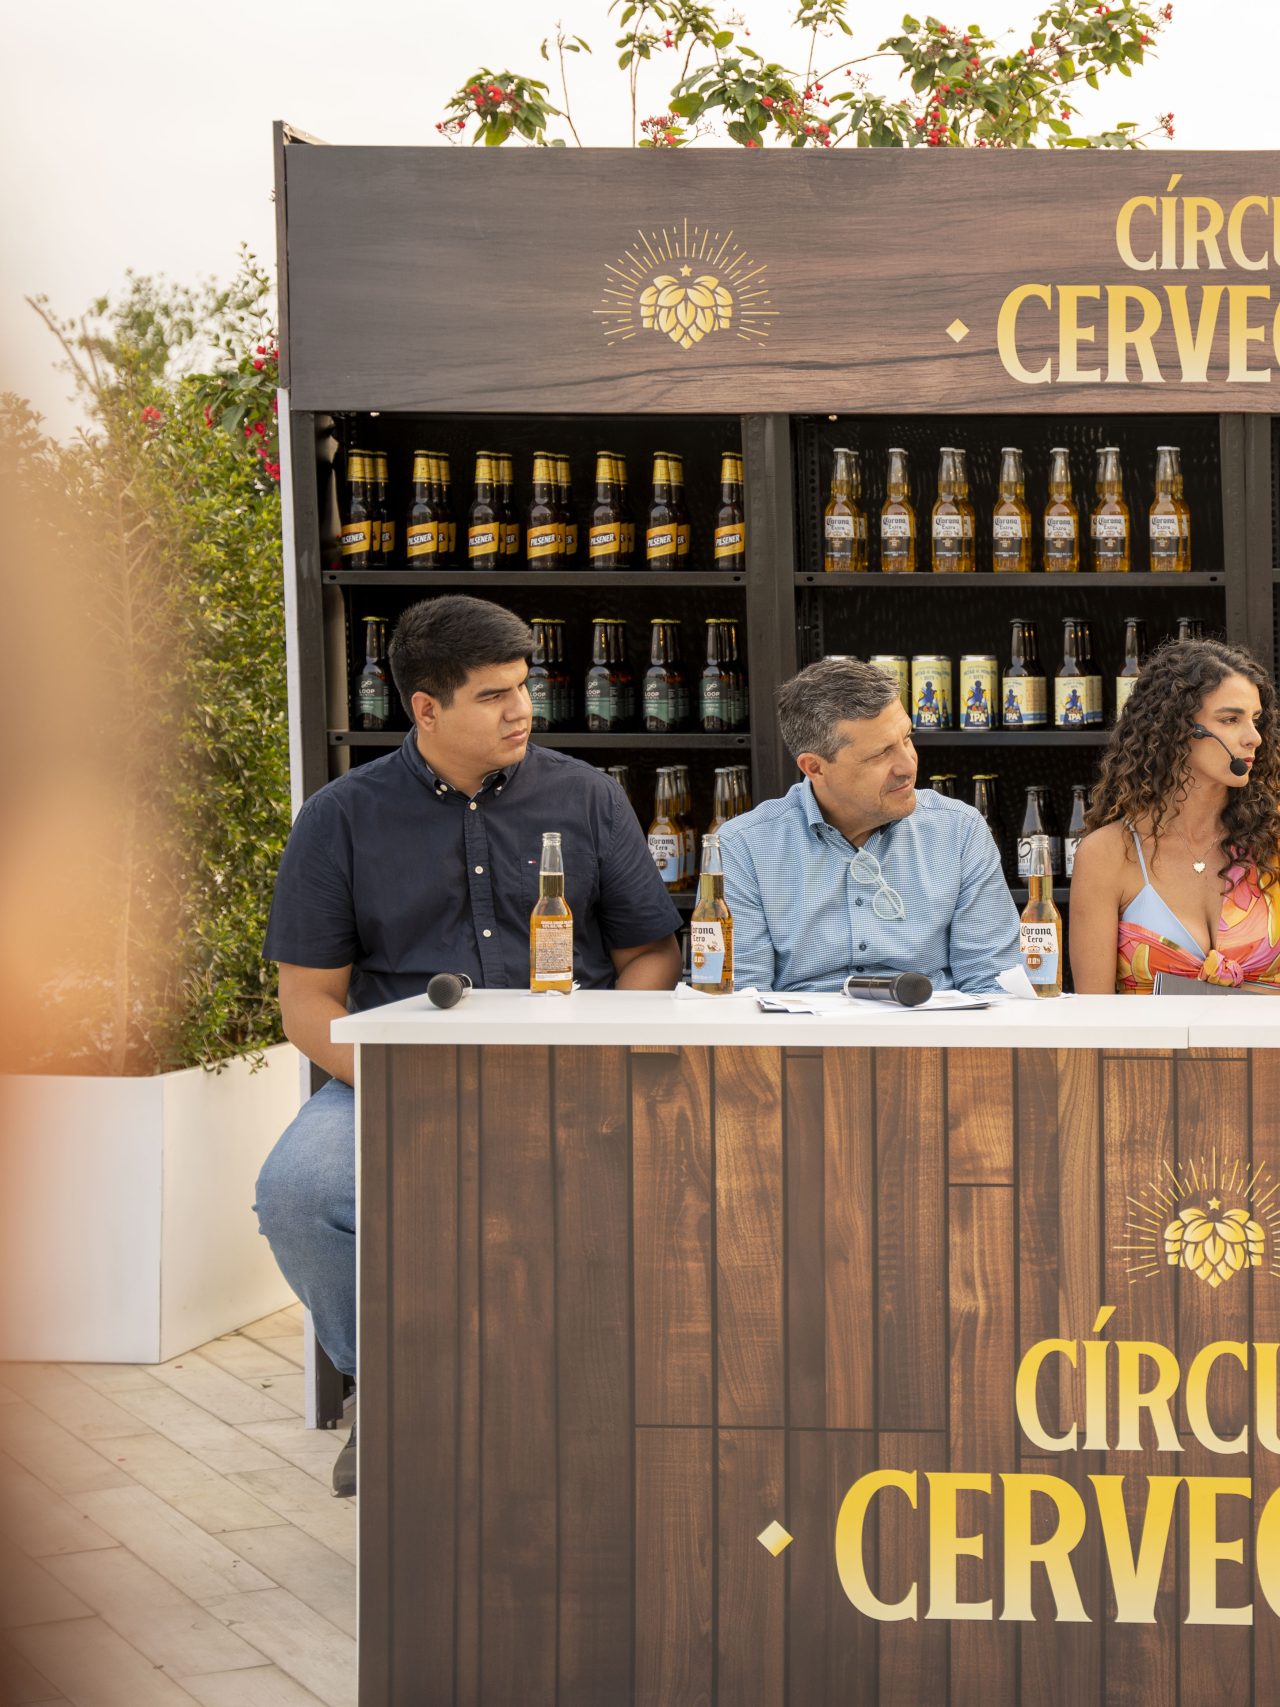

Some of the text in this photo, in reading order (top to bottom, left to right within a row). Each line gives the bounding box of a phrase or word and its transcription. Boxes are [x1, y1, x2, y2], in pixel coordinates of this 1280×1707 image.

[341, 532, 364, 545] ILSENER
[408, 533, 432, 545] PILSENER
[530, 535, 556, 547] PILSENER
[590, 534, 614, 546] PILSENER
[648, 534, 672, 547] PILSENER
[716, 534, 740, 547] PILSENER
[921, 714, 937, 723] IPA
[970, 714, 986, 722] IPA
[649, 837, 675, 846] Corona
[692, 926, 716, 936] orona
[1021, 925, 1052, 937] Corona
